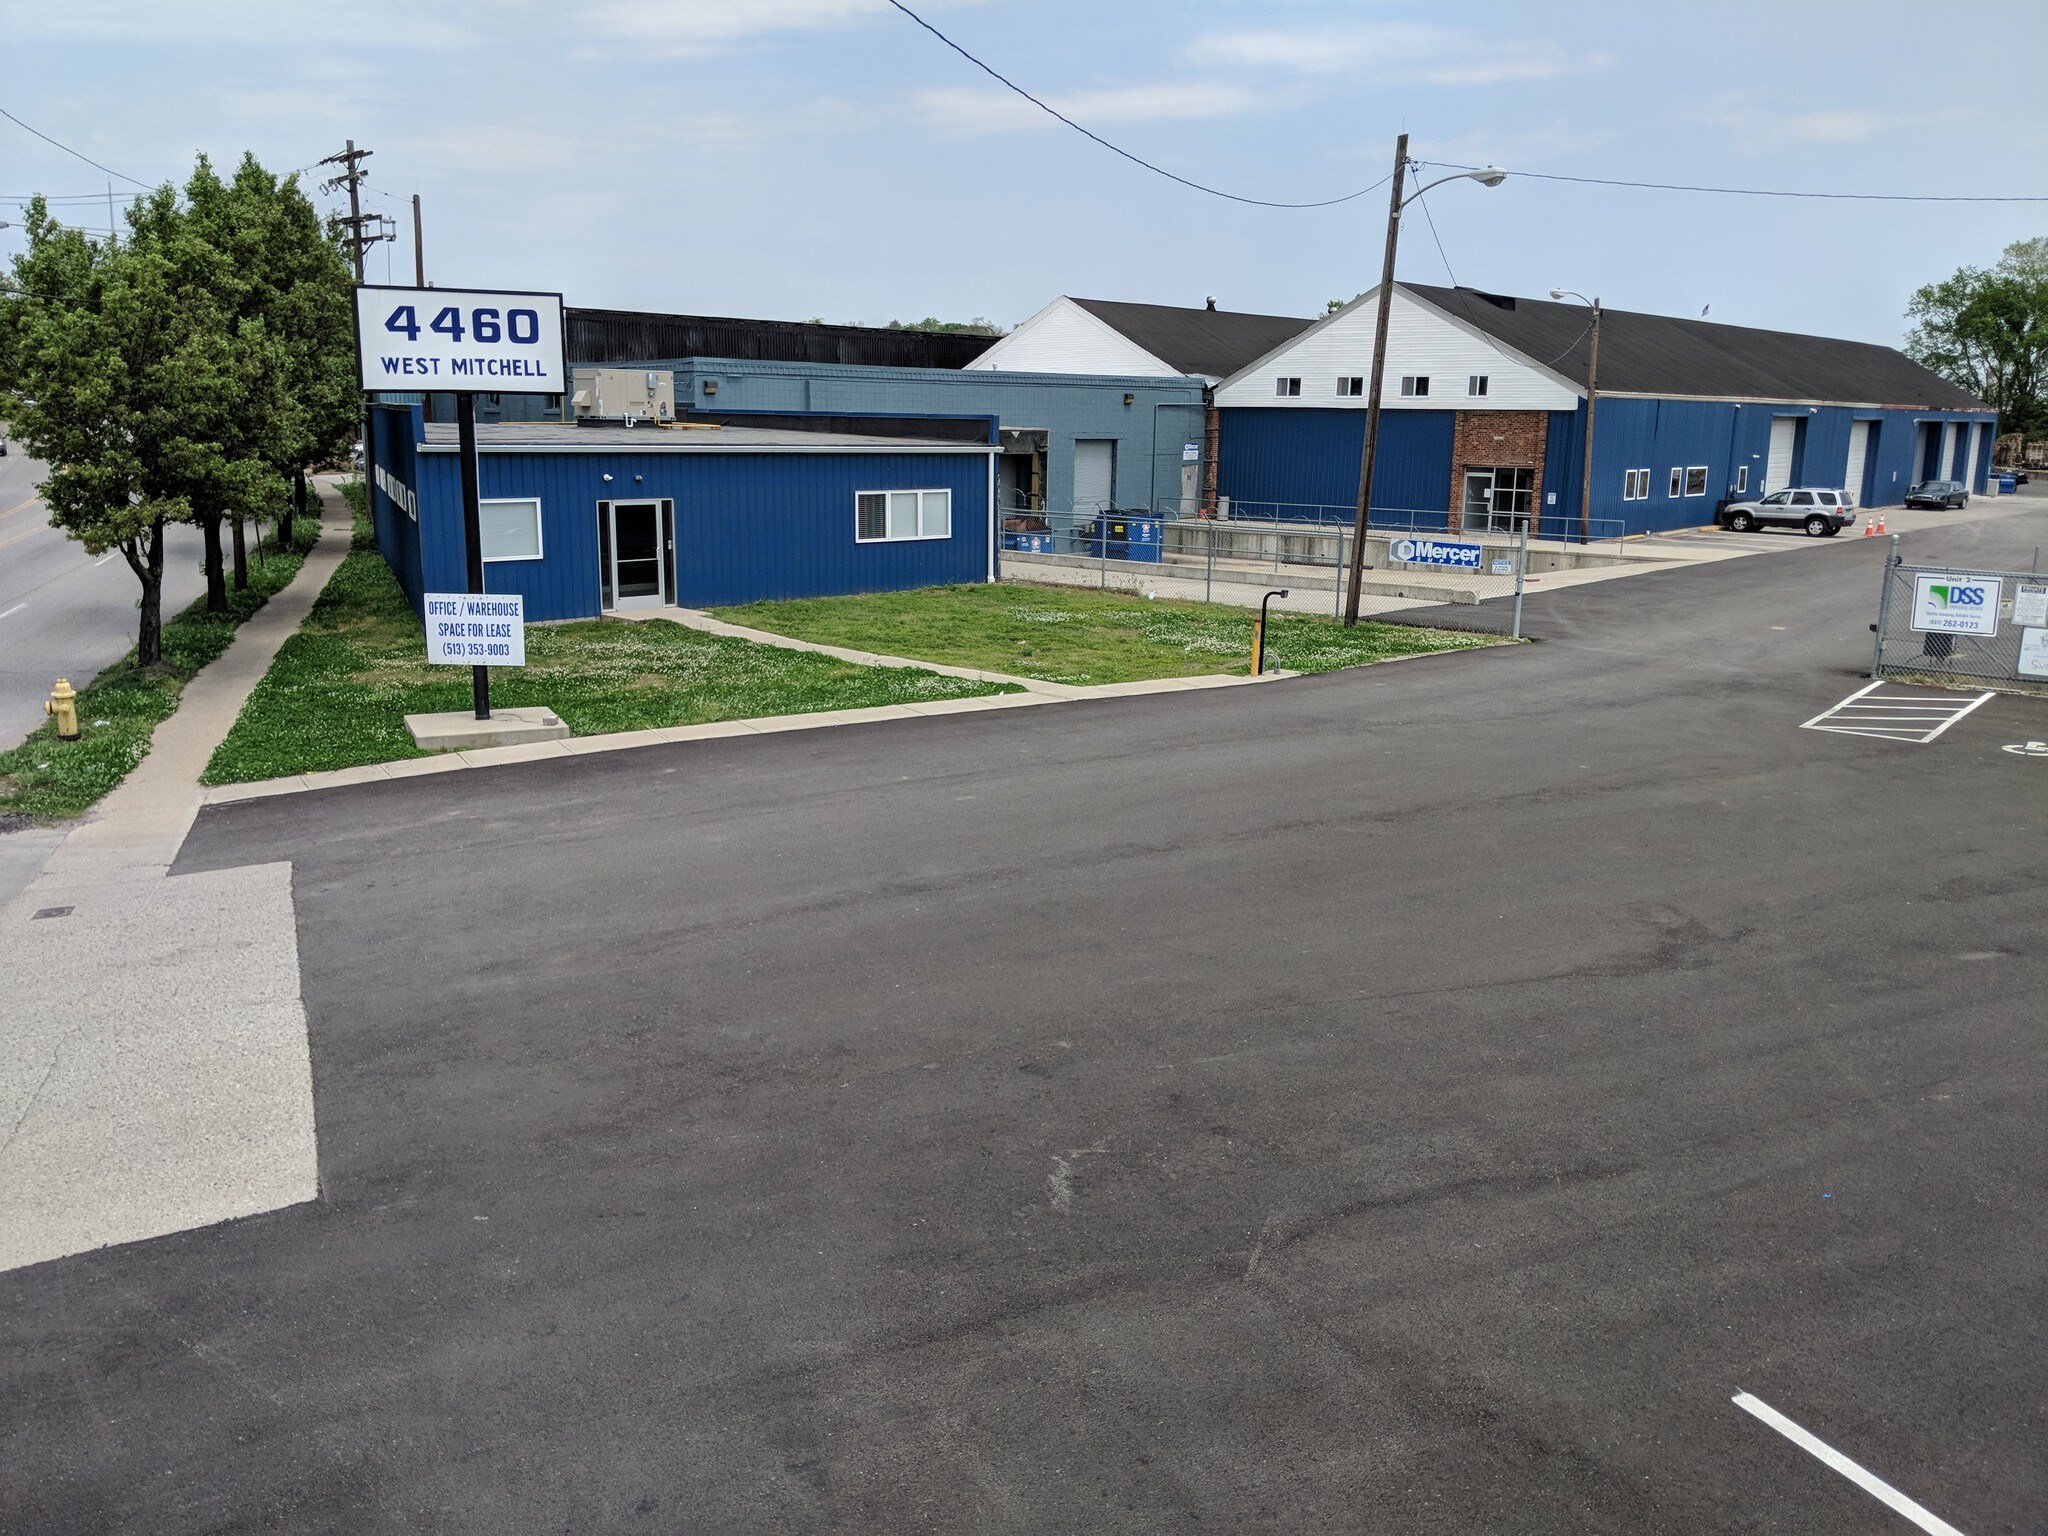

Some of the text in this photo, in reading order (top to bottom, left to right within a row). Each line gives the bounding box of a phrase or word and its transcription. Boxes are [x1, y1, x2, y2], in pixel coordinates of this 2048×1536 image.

[384, 305, 539, 344] 4460
[381, 357, 547, 377] WEST MITCHELL
[1415, 541, 1479, 562] Mercer
[1416, 557, 1478, 567] SUPPLY
[1949, 586, 1985, 605] DSS
[428, 601, 520, 617] OFFICE / WAREHOUSE
[438, 622, 512, 638] SPACE FOR LEASE
[1943, 619, 1979, 629] 262-0123
[443, 642, 510, 657] (513) 353-9003
